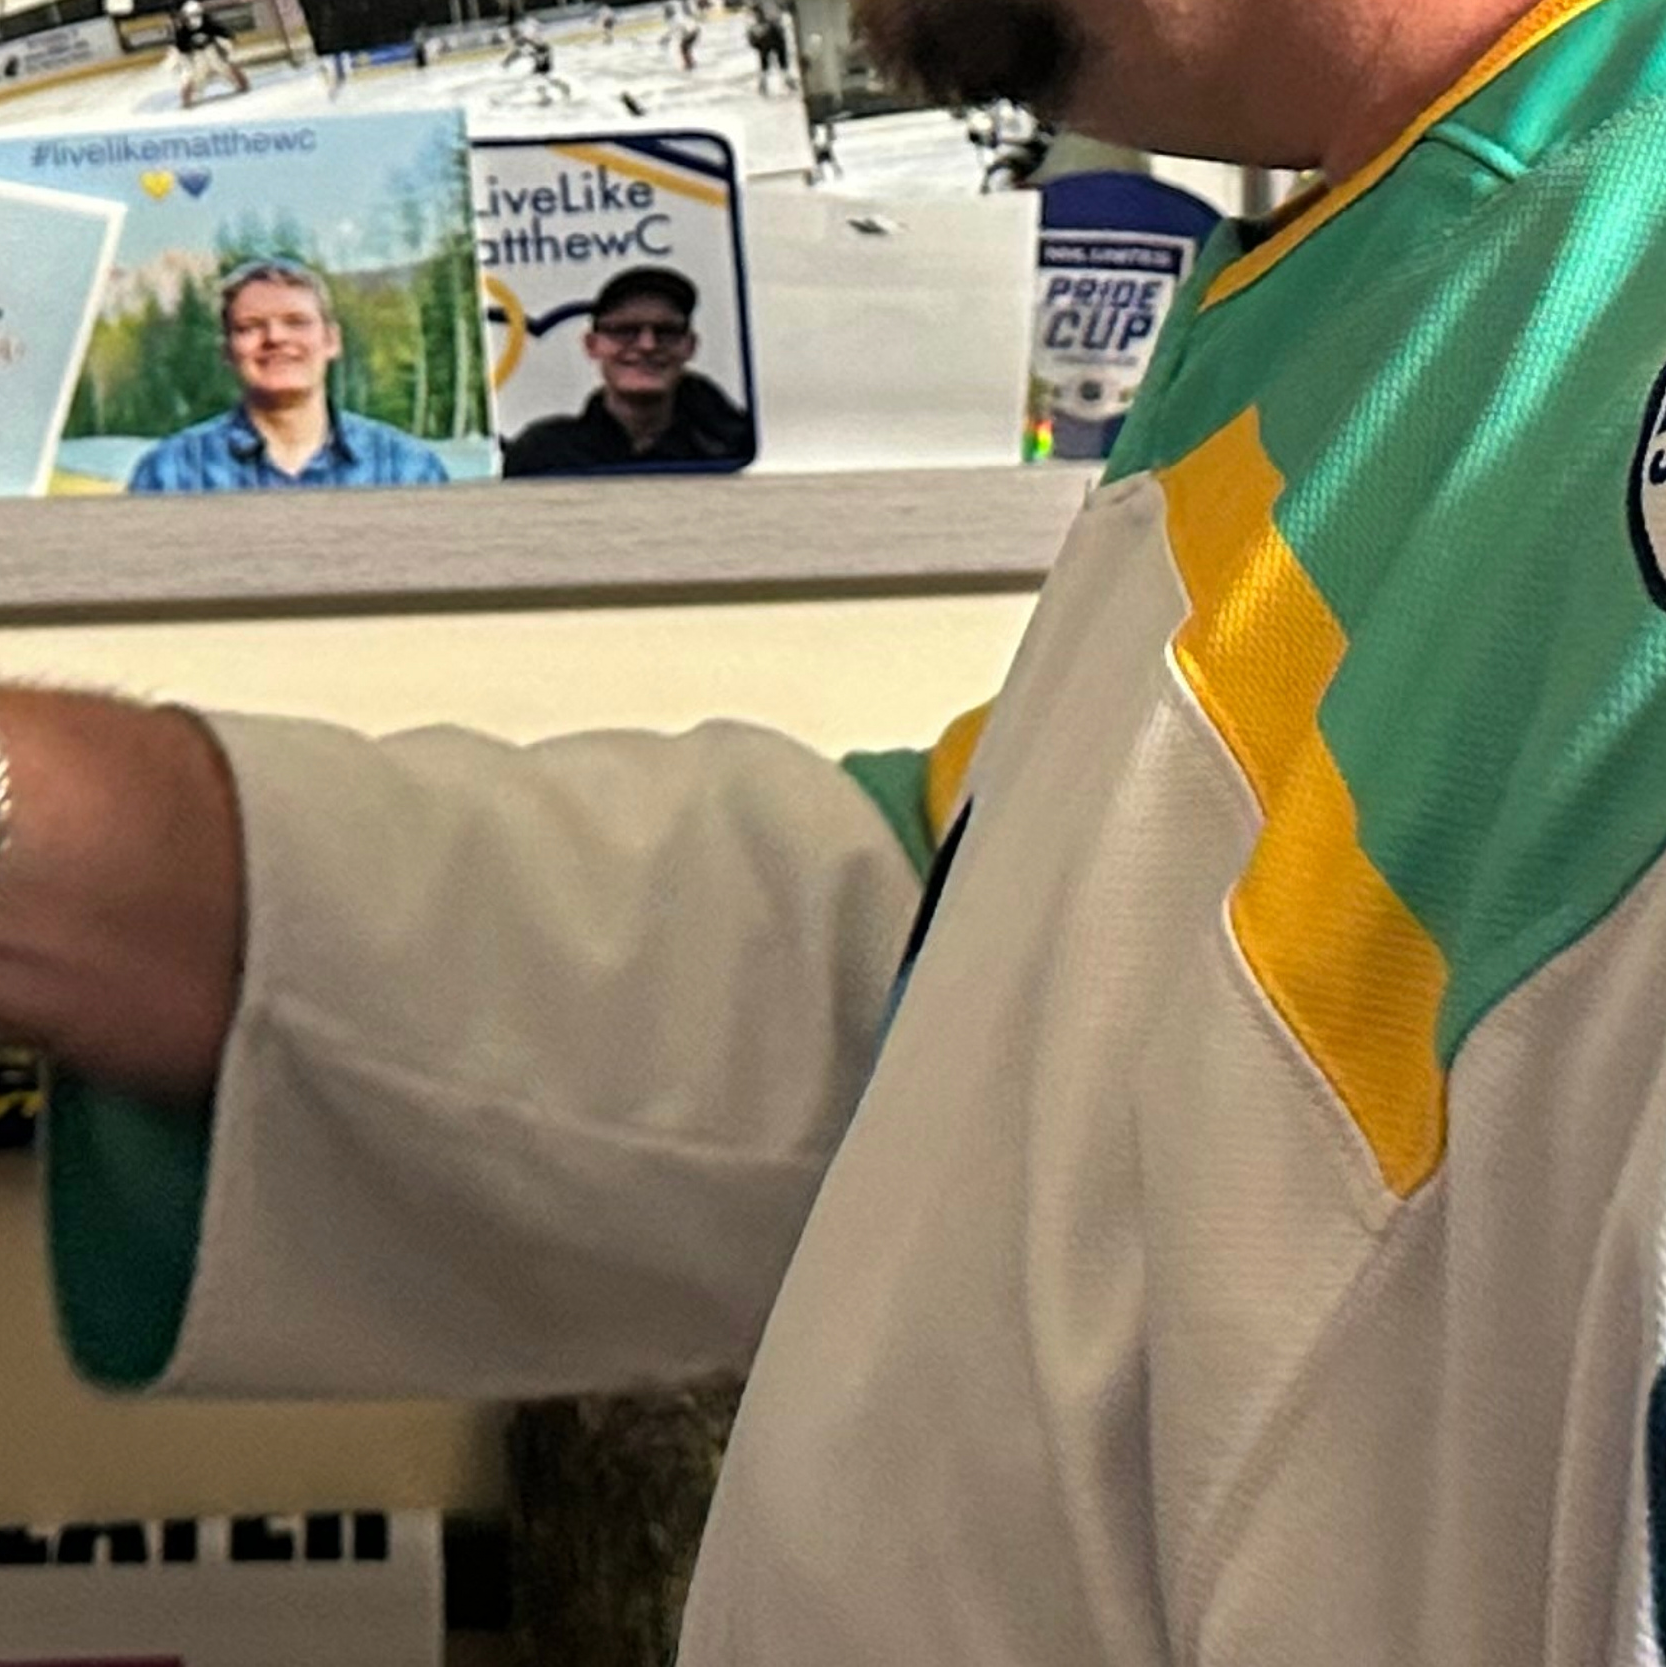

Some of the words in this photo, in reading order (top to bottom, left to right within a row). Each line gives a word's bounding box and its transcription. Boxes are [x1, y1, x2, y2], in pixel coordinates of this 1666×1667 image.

[31, 127, 317, 167] #livelikematthewc
[477, 214, 672, 265] atthewC
[1047, 277, 1163, 312] PRIDE
[1045, 311, 1154, 351] CUP
